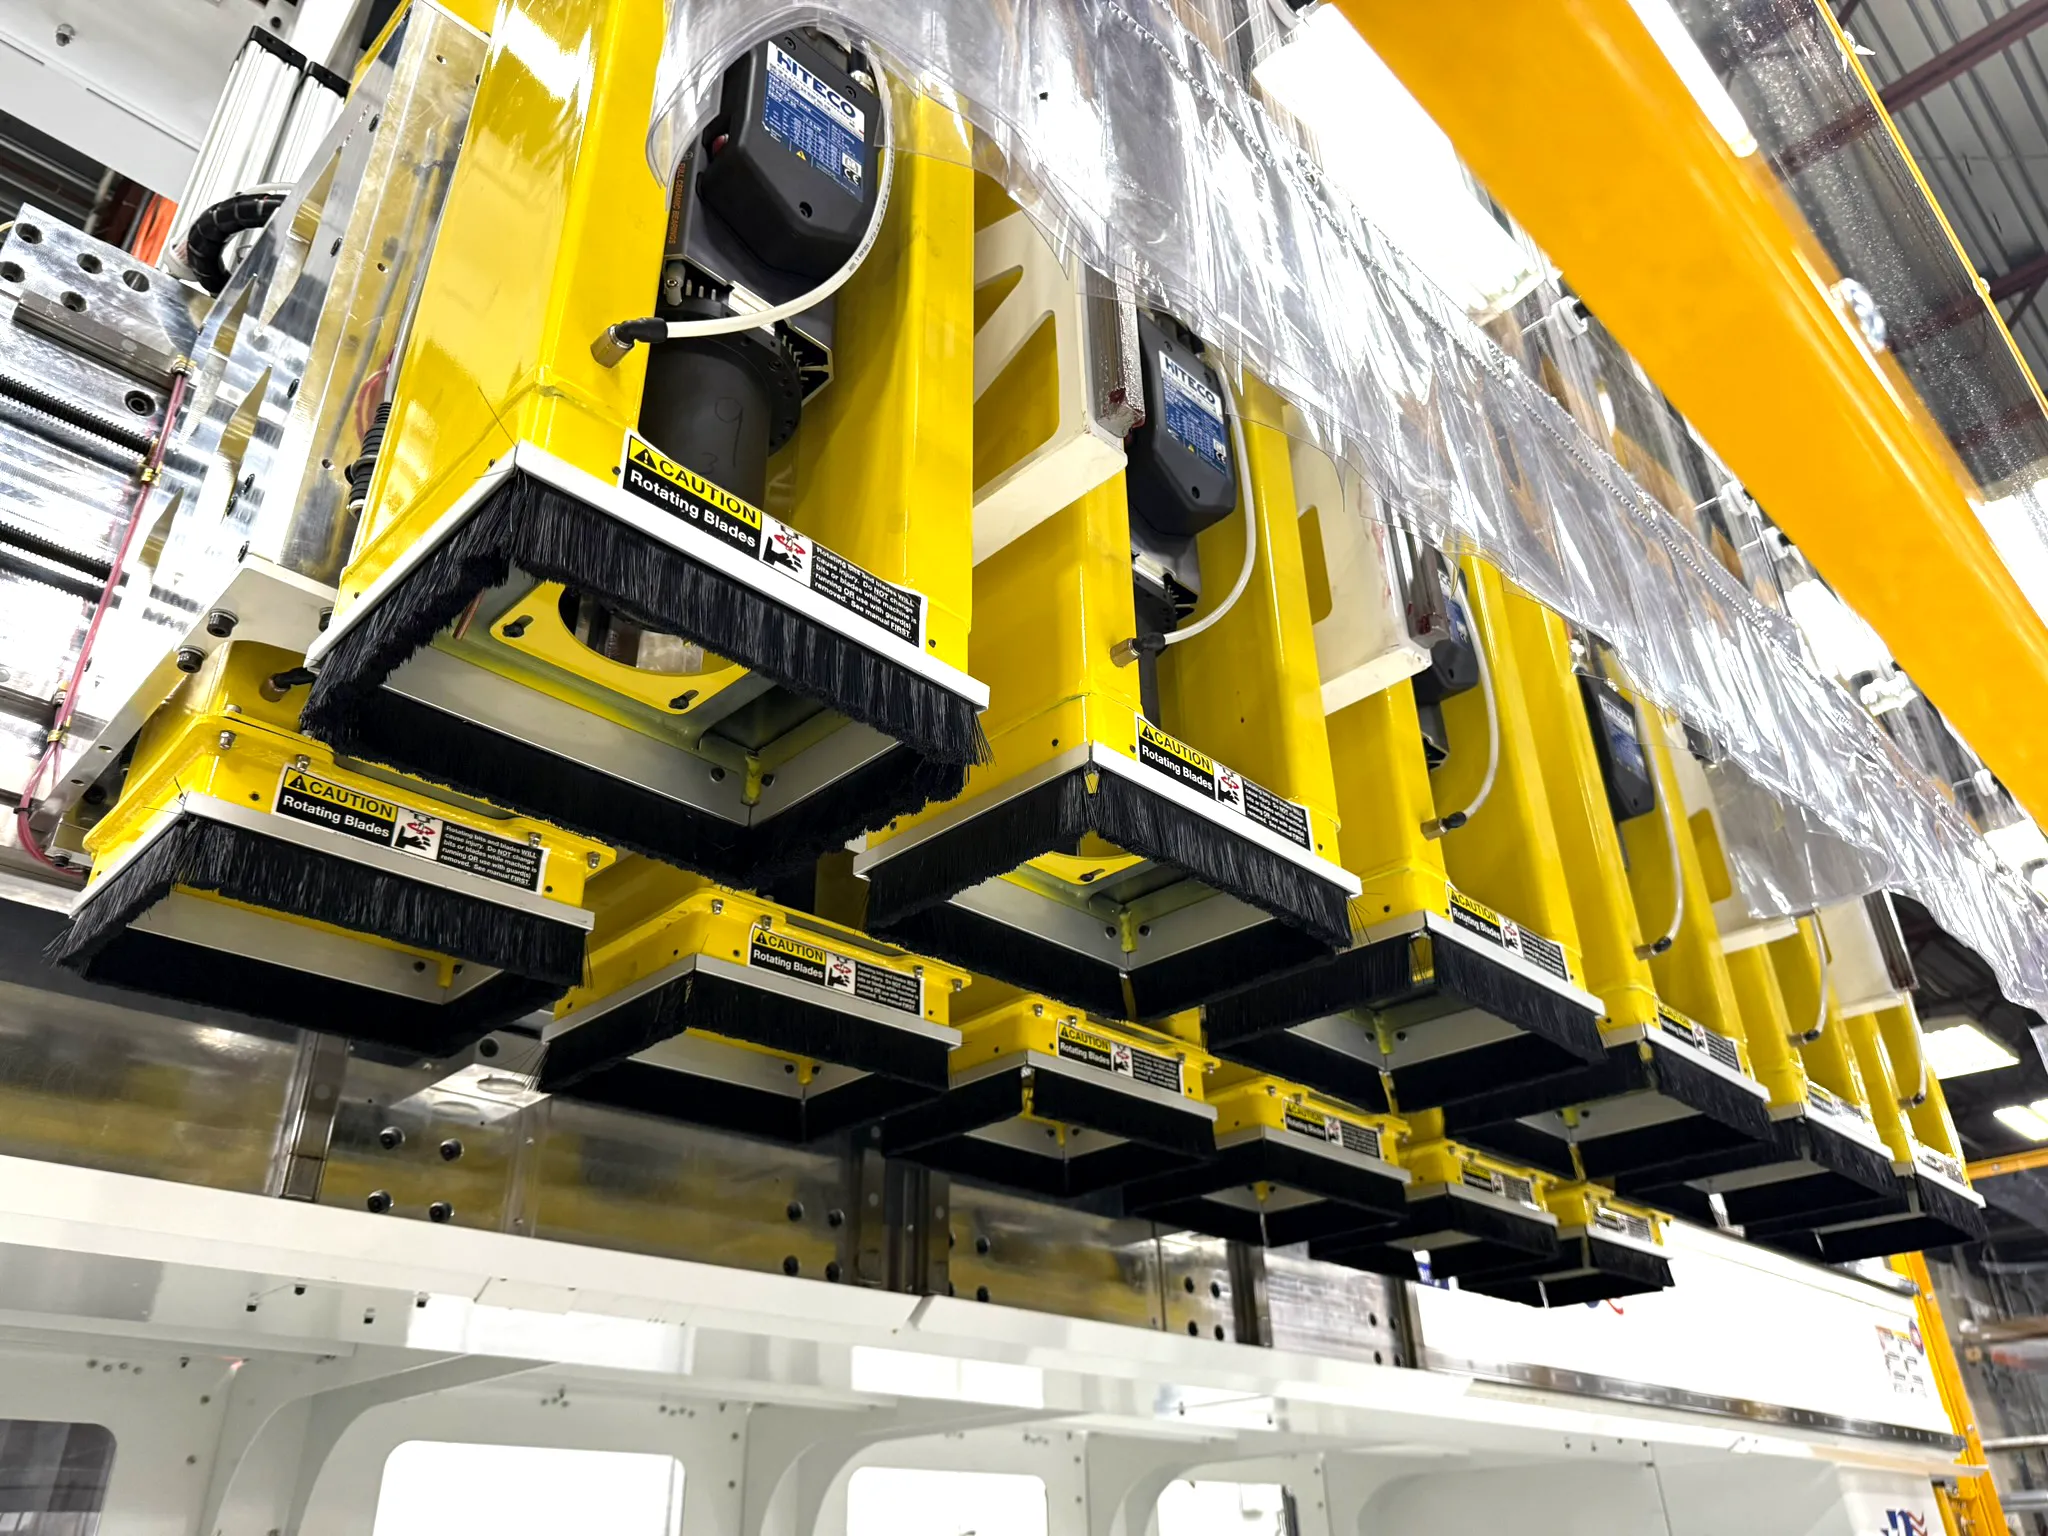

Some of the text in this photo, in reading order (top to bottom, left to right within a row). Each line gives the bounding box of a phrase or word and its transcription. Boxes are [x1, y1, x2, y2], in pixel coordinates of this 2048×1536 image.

[777, 51, 855, 117] HITECO
[1165, 357, 1215, 404] HITECO
[630, 469, 754, 546] Rotating Blades
[659, 460, 755, 522] CAUTION
[1142, 744, 1212, 790] Rotating Blades
[1154, 732, 1209, 770] CAUTION
[283, 795, 388, 836] Rotating Blades
[309, 781, 391, 817] CAUTION
[753, 949, 822, 977] Rotating Blades
[768, 936, 822, 961] CAUTION
[1059, 1041, 1109, 1064] Rotating Blades
[1068, 1029, 1110, 1050] CAUTION
